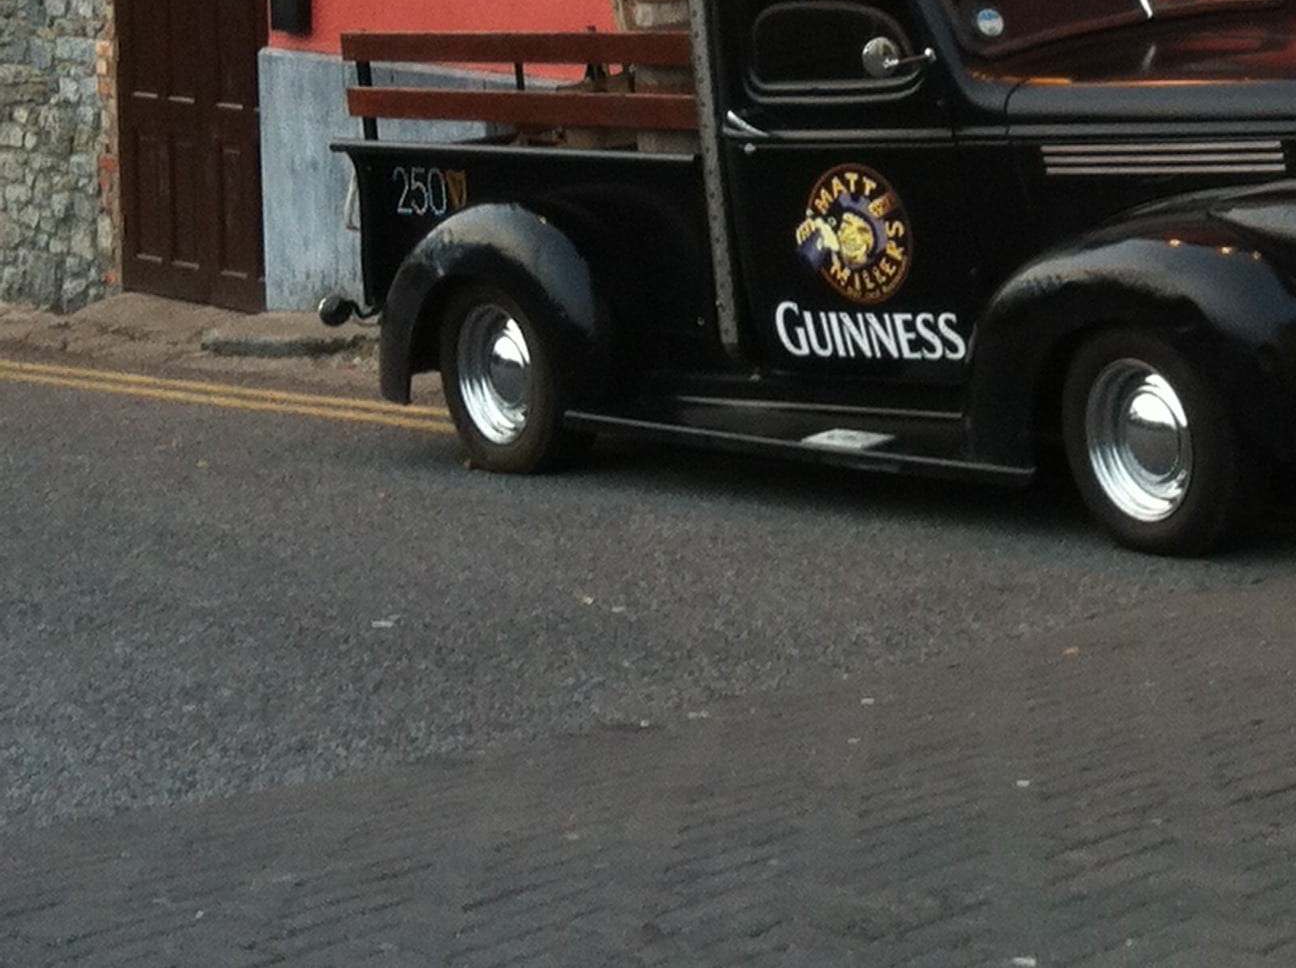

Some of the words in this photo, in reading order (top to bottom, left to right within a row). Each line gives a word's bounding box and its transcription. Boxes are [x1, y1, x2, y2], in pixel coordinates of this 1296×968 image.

[814, 173, 877, 214] MATT
[830, 220, 905, 291] MILLERS
[775, 300, 967, 361] GUINNESS
